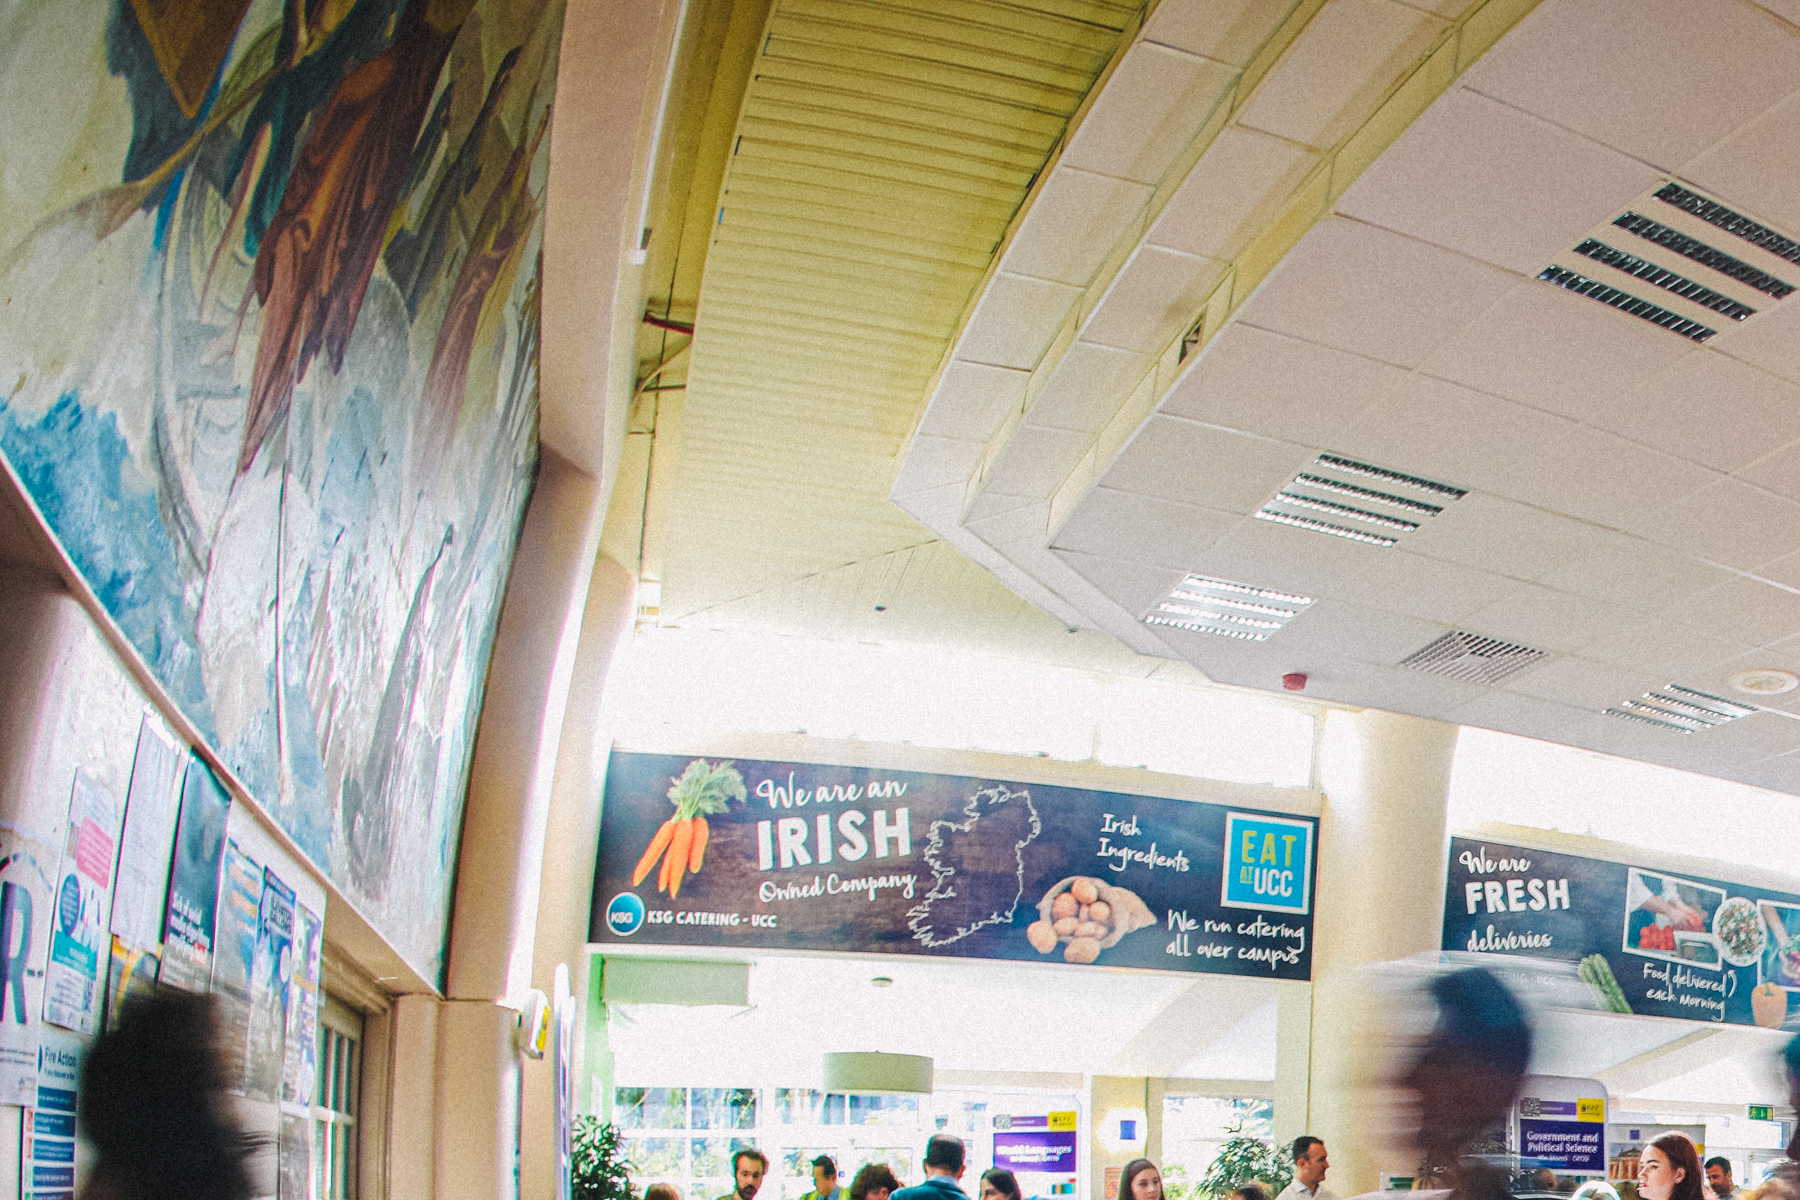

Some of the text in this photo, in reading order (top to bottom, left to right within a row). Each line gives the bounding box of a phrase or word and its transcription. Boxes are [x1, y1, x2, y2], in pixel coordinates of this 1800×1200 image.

[756, 771, 908, 809] We are an
[757, 806, 912, 871] IRISH
[1100, 813, 1143, 837] Irish
[1096, 837, 1191, 872] Ingredients
[1241, 830, 1297, 867] EAT
[1459, 846, 1532, 874] We are
[759, 873, 918, 903] Owned Company
[1253, 867, 1293, 897] UCC
[1464, 877, 1571, 915] FRESH
[610, 911, 633, 924] KSG
[647, 910, 674, 924] KSG
[675, 911, 741, 926] CATERING
[750, 913, 778, 928] UCC
[1167, 909, 1306, 954] We run catering
[1166, 933, 1299, 971] all over campus
[1467, 923, 1553, 953] deliveries
[1643, 962, 1727, 998] Food delivered
[1646, 983, 1677, 1002] each
[1527, 1131, 1599, 1143] Government and
[1527, 1142, 1599, 1154] Political Science
